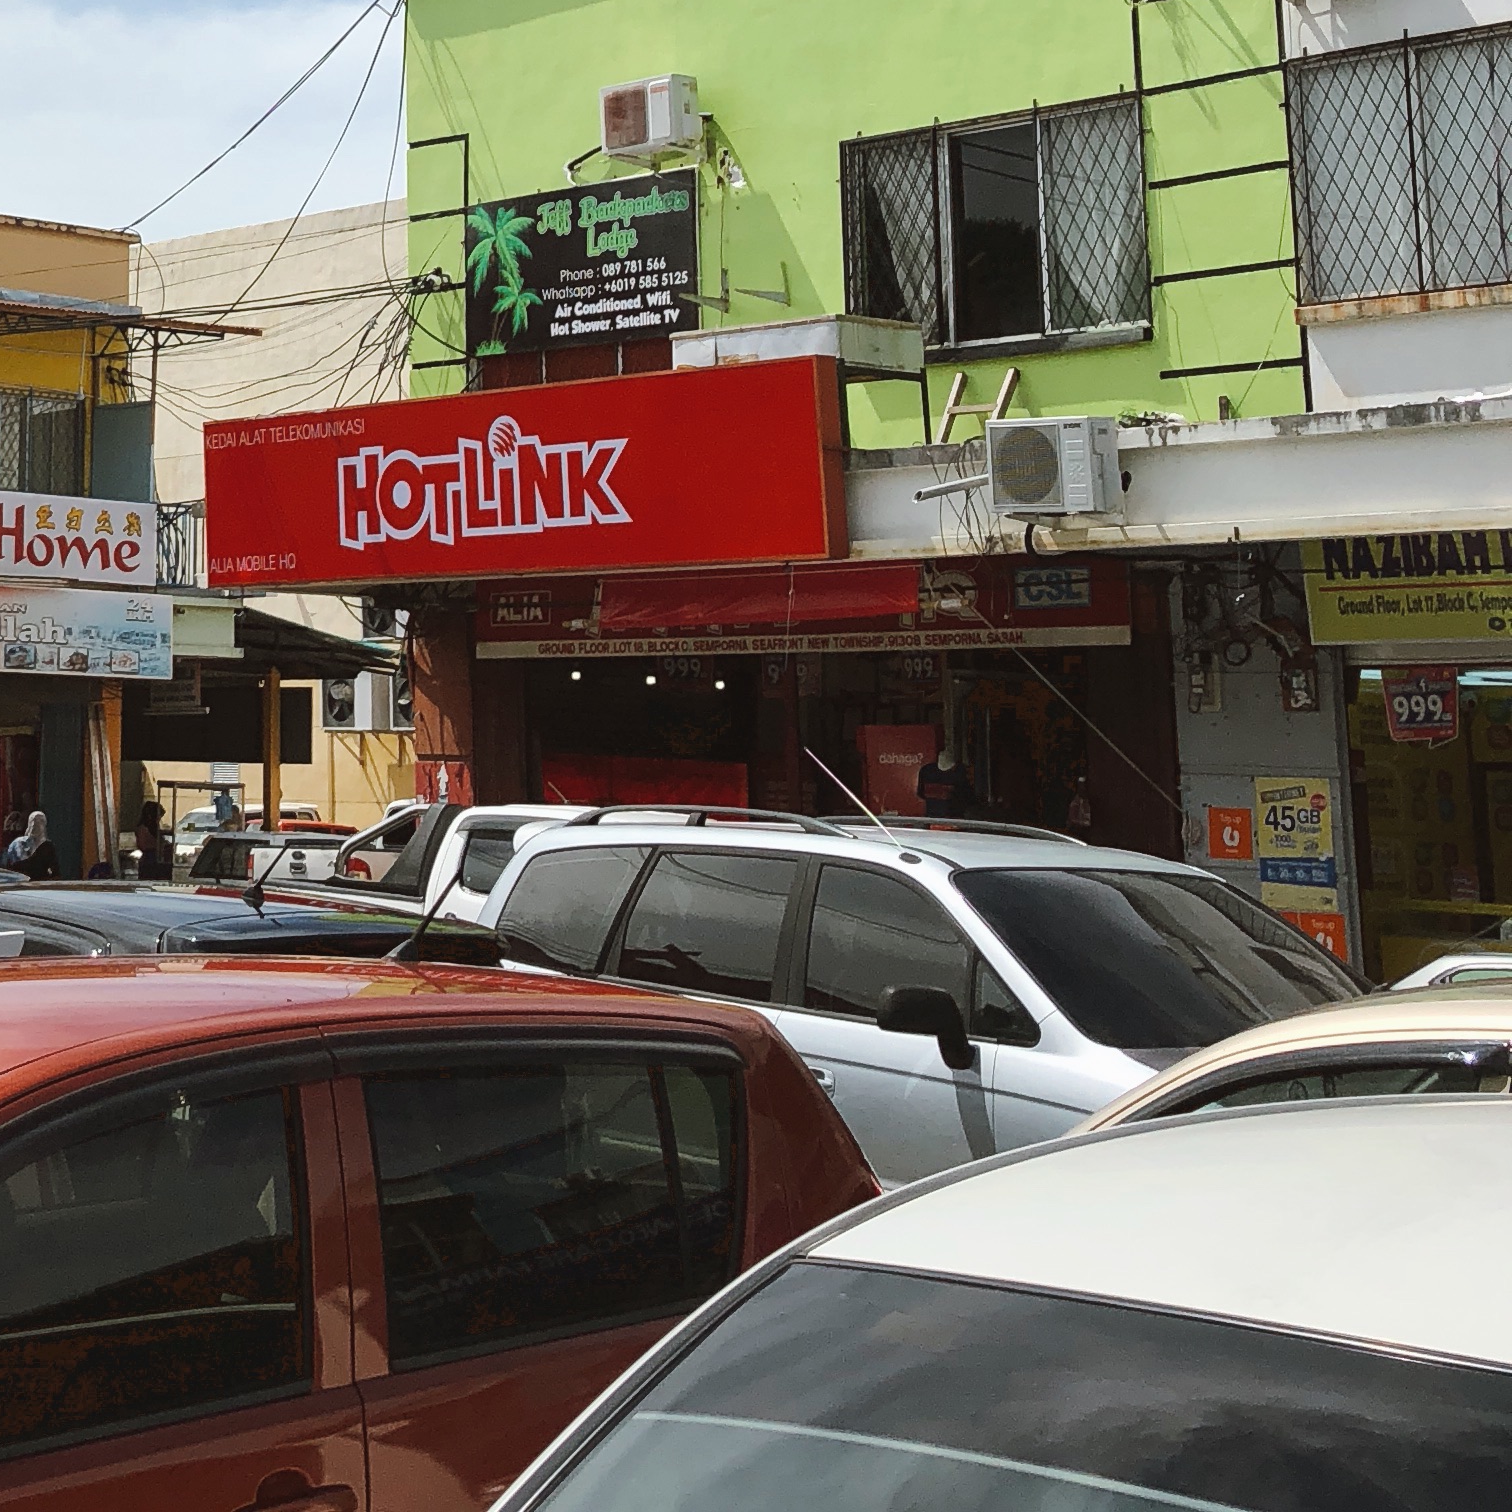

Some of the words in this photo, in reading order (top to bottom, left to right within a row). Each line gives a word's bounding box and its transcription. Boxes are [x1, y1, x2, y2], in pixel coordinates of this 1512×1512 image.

[537, 198, 572, 236] Jeff
[578, 186, 689, 227] Backpackers
[586, 222, 639, 258] Lodge
[560, 266, 594, 283] Phone
[601, 261, 621, 277] 089
[624, 259, 642, 275] 781
[646, 257, 666, 272] 566
[542, 284, 595, 304] Whatsapp
[603, 276, 636, 292] +6019
[639, 274, 659, 289] 585
[662, 271, 688, 286] 5125
[550, 322, 570, 338] Hot
[615, 311, 662, 330] Satellite
[664, 308, 680, 323] TV
[554, 303, 572, 319] Air
[205, 433, 237, 449] KEDAI
[239, 428, 267, 447] ALAT
[269, 418, 365, 444] TELEKOMUNIKASI
[210, 557, 235, 574] ALIA
[236, 554, 276, 572] MOBILE
[279, 552, 297, 569] HQ
[125, 597, 154, 614] 24
[496, 595, 543, 622] ALIA
[1338, 595, 1374, 615] Ground
[1406, 593, 1424, 613] Lot
[538, 643, 576, 655] GROUND
[693, 638, 749, 652] SEMPORNA
[751, 637, 803, 651] SEAFRONT
[808, 636, 830, 649] NEW
[1392, 694, 1443, 723] 999
[879, 752, 924, 767] dahaga?
